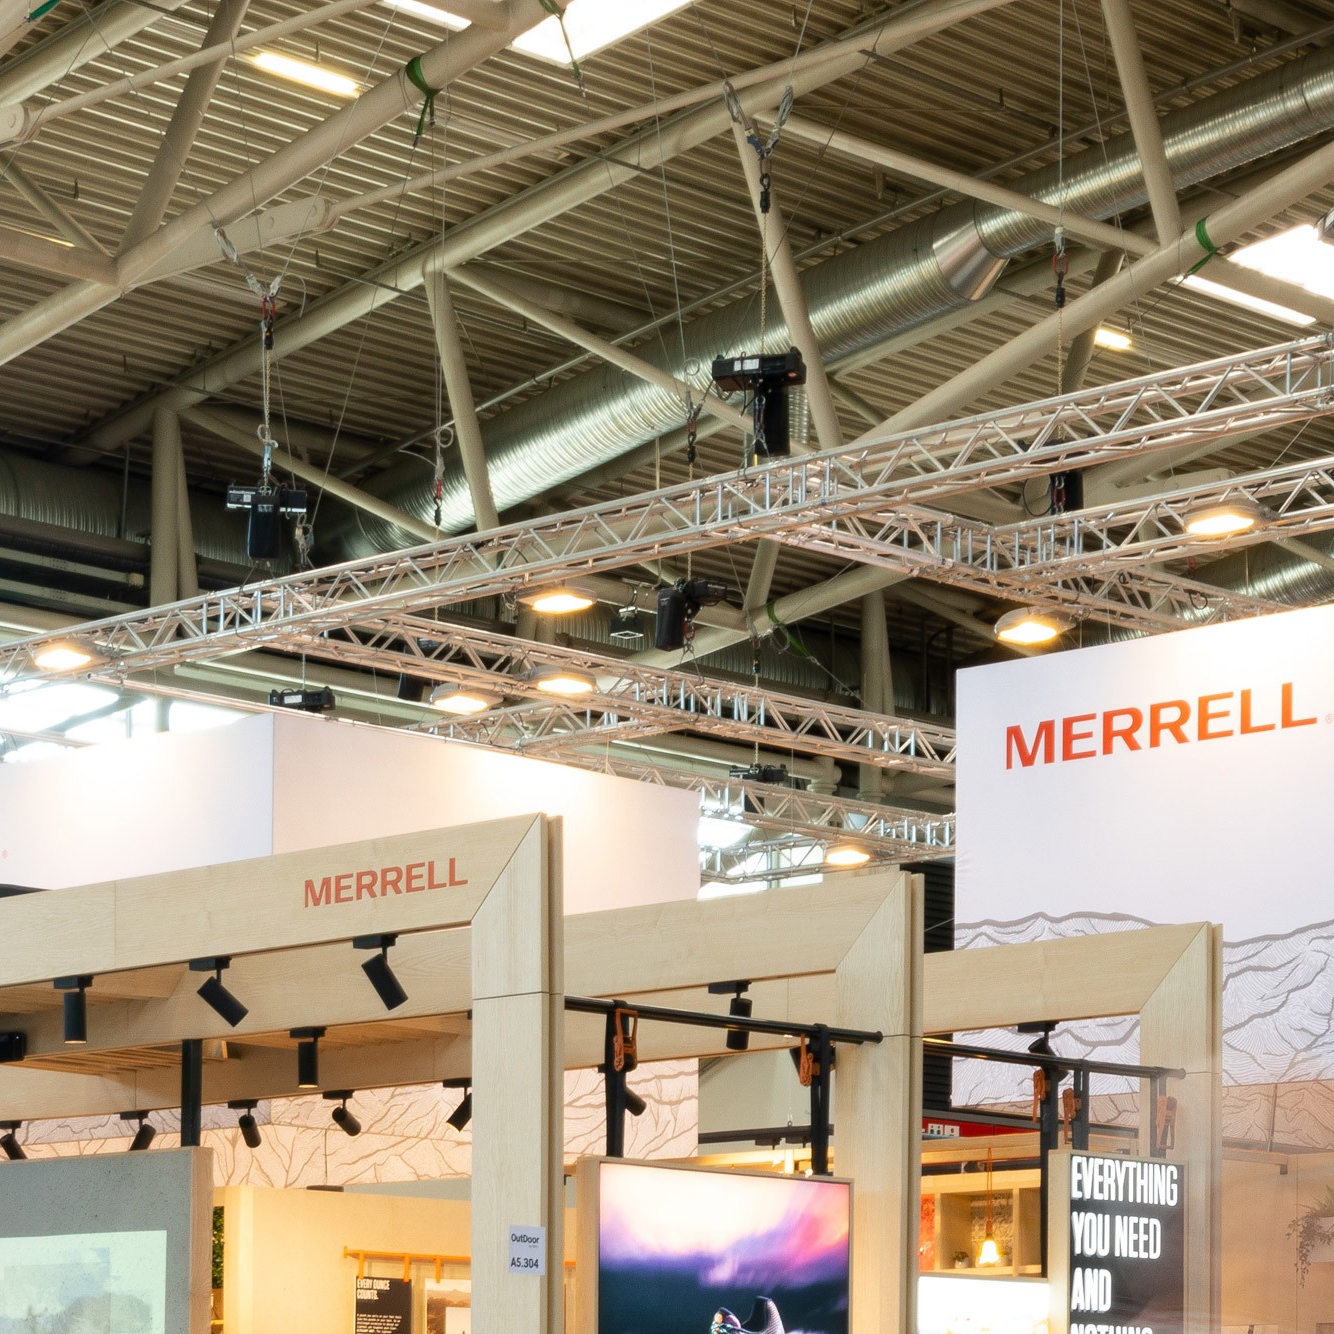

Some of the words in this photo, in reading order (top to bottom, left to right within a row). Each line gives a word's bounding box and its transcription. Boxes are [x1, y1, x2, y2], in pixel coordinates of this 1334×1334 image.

[1005, 682, 1318, 769] MERRELL
[303, 856, 469, 908] MERRELL
[1071, 1155, 1178, 1207] EVERYTHING
[511, 1233, 539, 1244] OutDoor
[1072, 1211, 1110, 1257] YOU
[1115, 1214, 1162, 1259] NEED
[357, 1279, 373, 1289] EVERY
[510, 1257, 539, 1269] A5.304
[1071, 1267, 1112, 1313] AND
